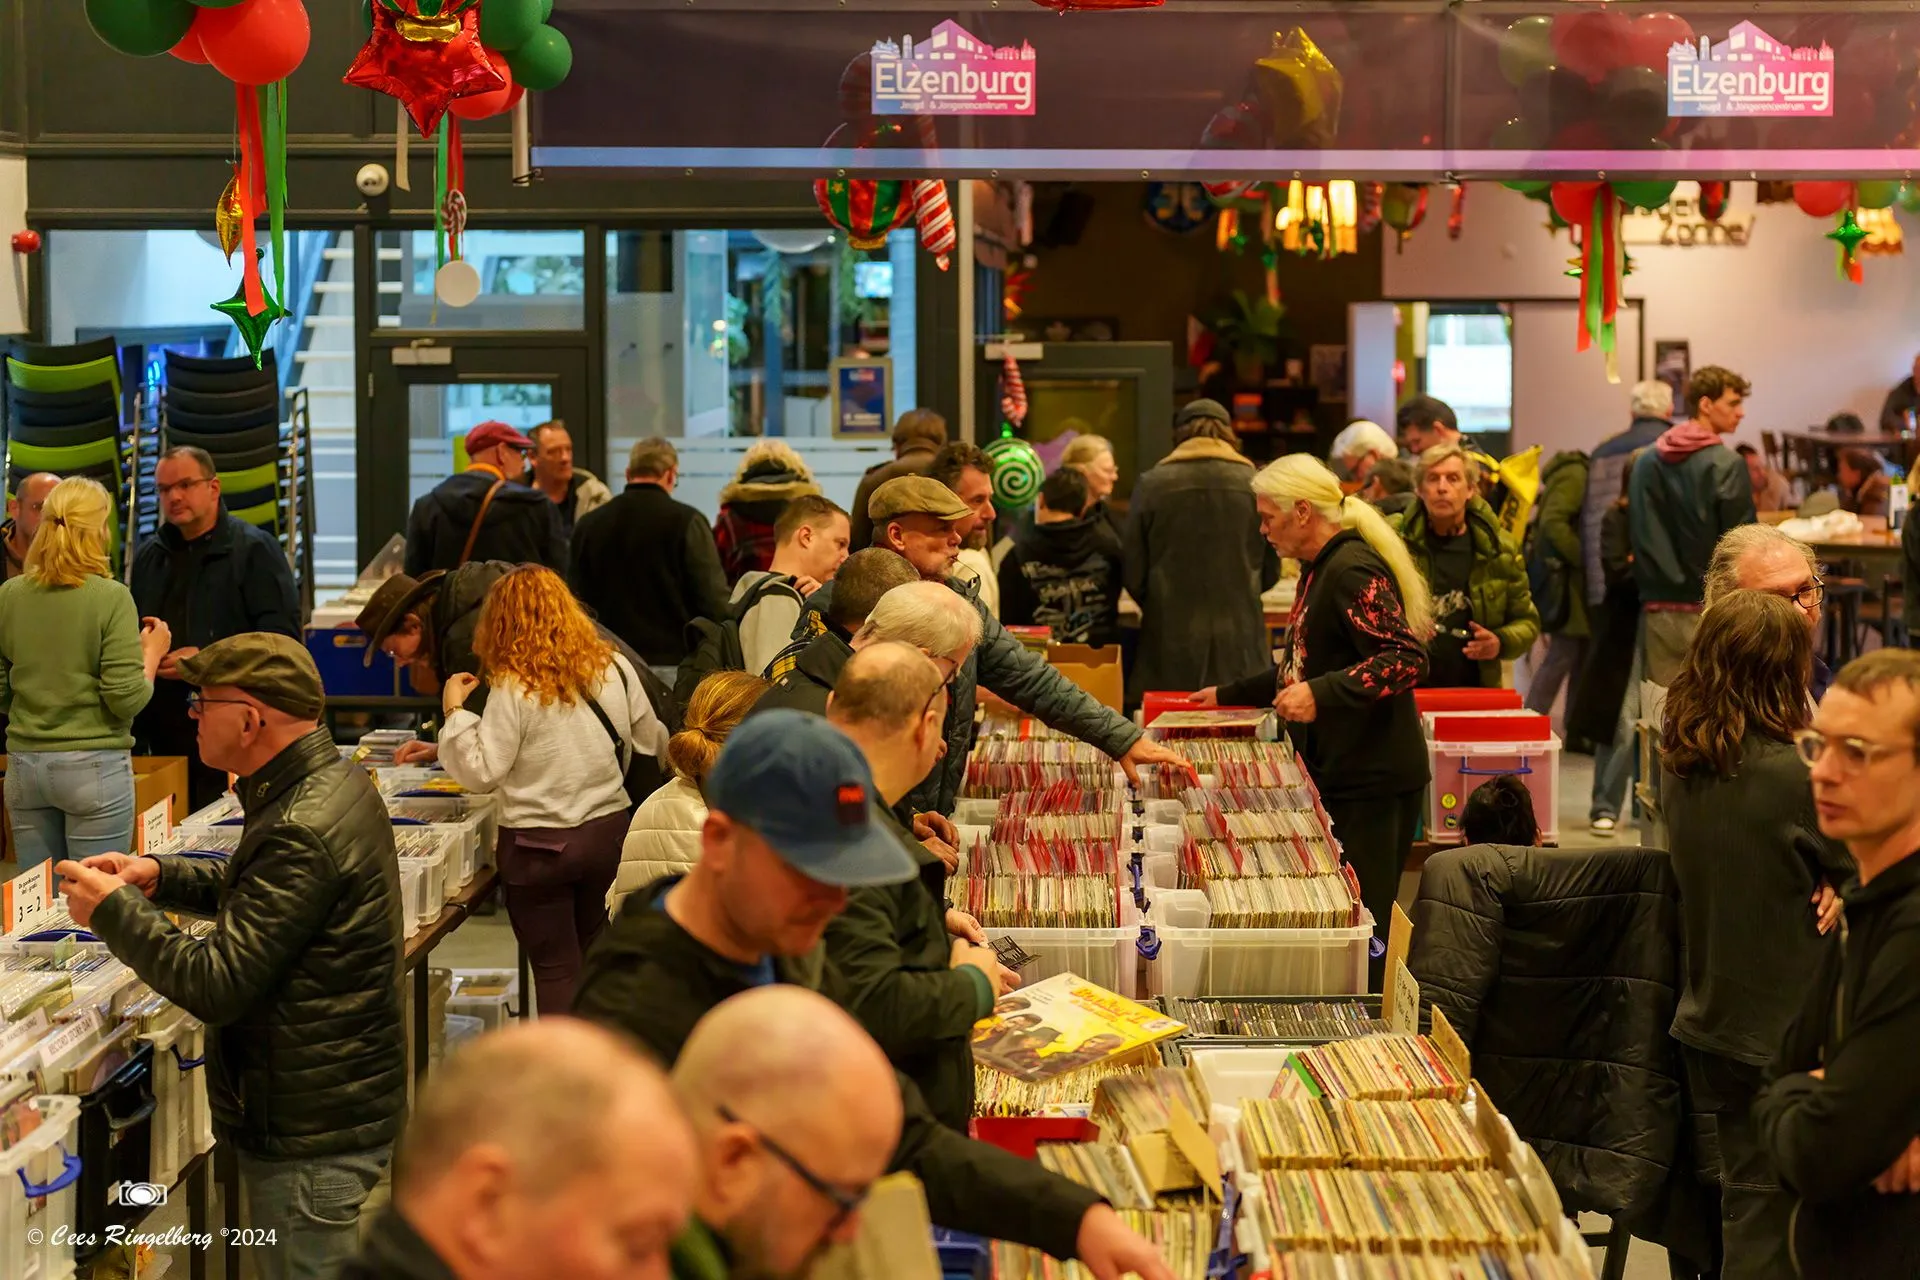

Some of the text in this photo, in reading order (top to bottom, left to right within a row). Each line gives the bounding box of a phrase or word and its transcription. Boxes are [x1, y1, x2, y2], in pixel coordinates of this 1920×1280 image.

[875, 62, 1032, 110] Elzenburg
[1672, 63, 1830, 111] Elzenburg
[19, 895, 41, 923] 3 = 2
[48, 1016, 93, 1056] RECORD STORE DAY
